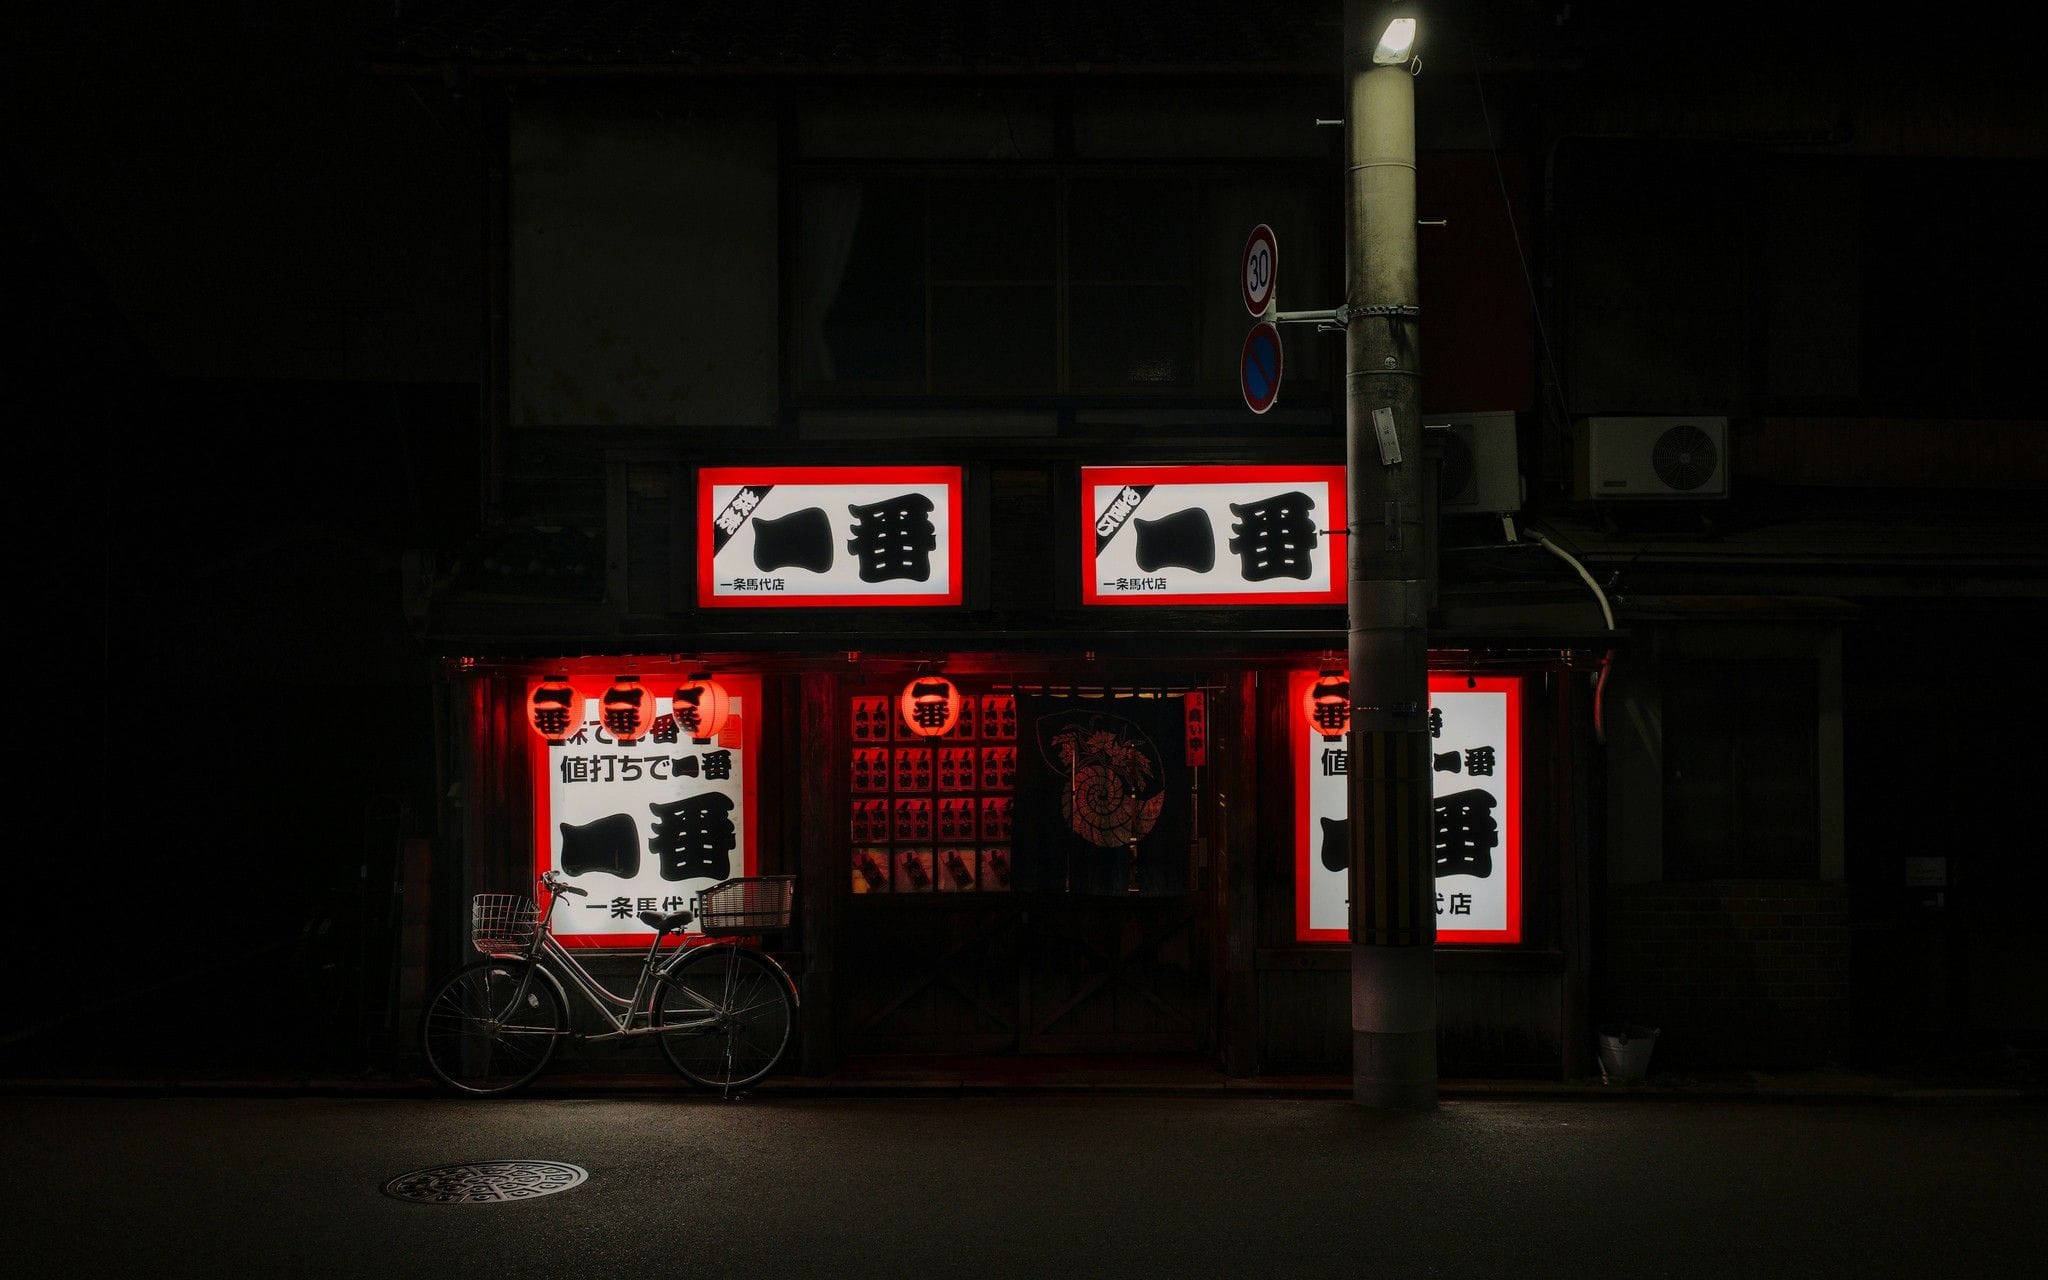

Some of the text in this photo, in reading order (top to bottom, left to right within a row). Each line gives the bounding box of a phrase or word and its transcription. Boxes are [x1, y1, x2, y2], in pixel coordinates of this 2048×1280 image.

[1250, 249, 1269, 292] 30
[752, 493, 937, 583] 一番
[1133, 491, 1318, 582] 一番
[720, 578, 785, 591] 一条馬代店
[1103, 577, 1167, 591] 一条馬代店
[533, 687, 574, 735] 一番
[603, 687, 645, 735] 一番
[912, 682, 951, 728] 一番
[1312, 681, 1350, 730] 一番
[560, 749, 732, 784] 値打ちで一番
[559, 791, 737, 882] 一番
